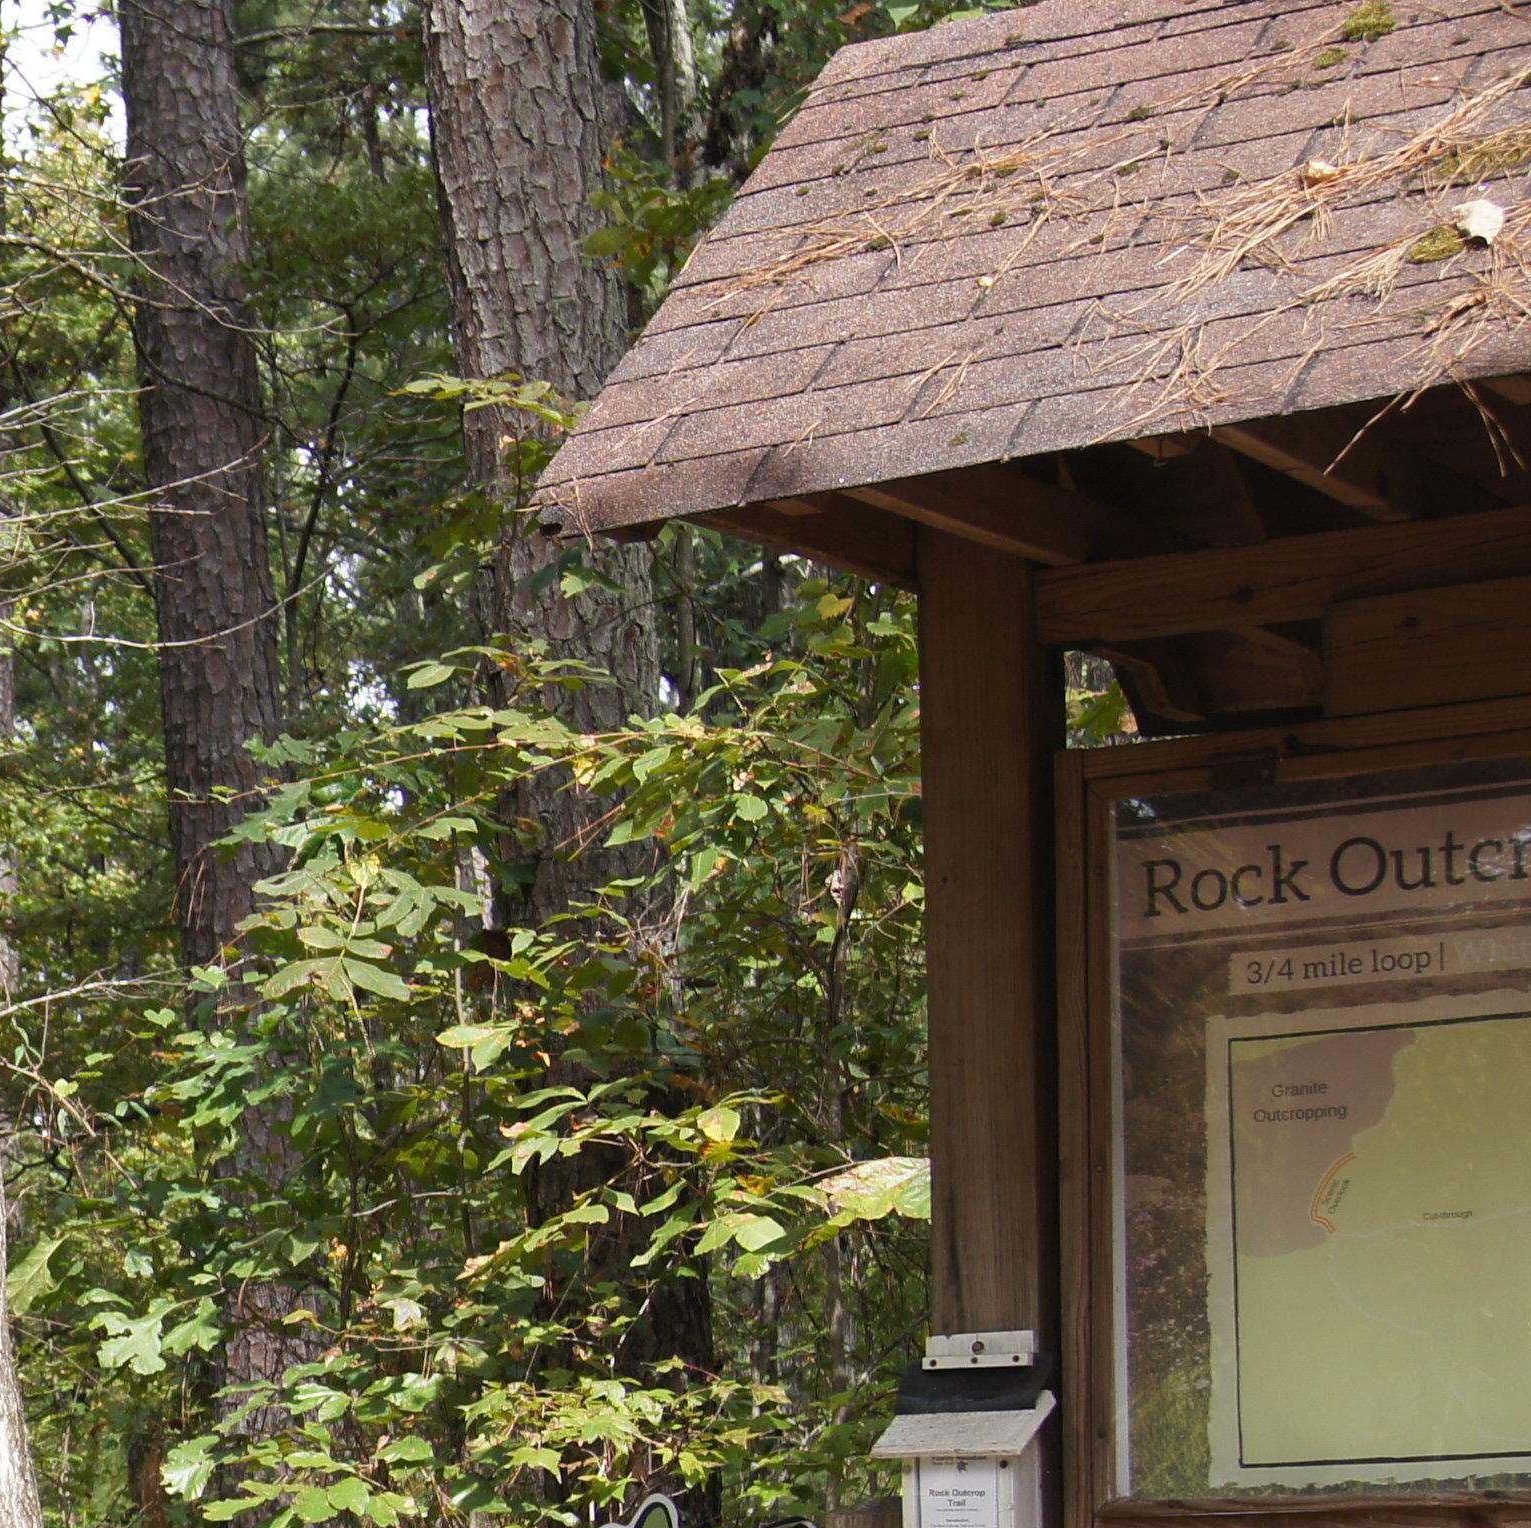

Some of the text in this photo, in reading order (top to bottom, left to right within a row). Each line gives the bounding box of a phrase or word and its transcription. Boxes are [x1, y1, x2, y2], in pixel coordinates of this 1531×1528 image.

[1142, 844, 1311, 918] Rock
[1246, 958, 1295, 987] 3/4
[1302, 954, 1364, 981] mile
[1371, 949, 1432, 980] loop
[1271, 1081, 1328, 1098] Granite
[1253, 1104, 1347, 1124] Outcropping
[929, 1489, 986, 1498] Rock Outcrop
[947, 1499, 966, 1507] Trail
